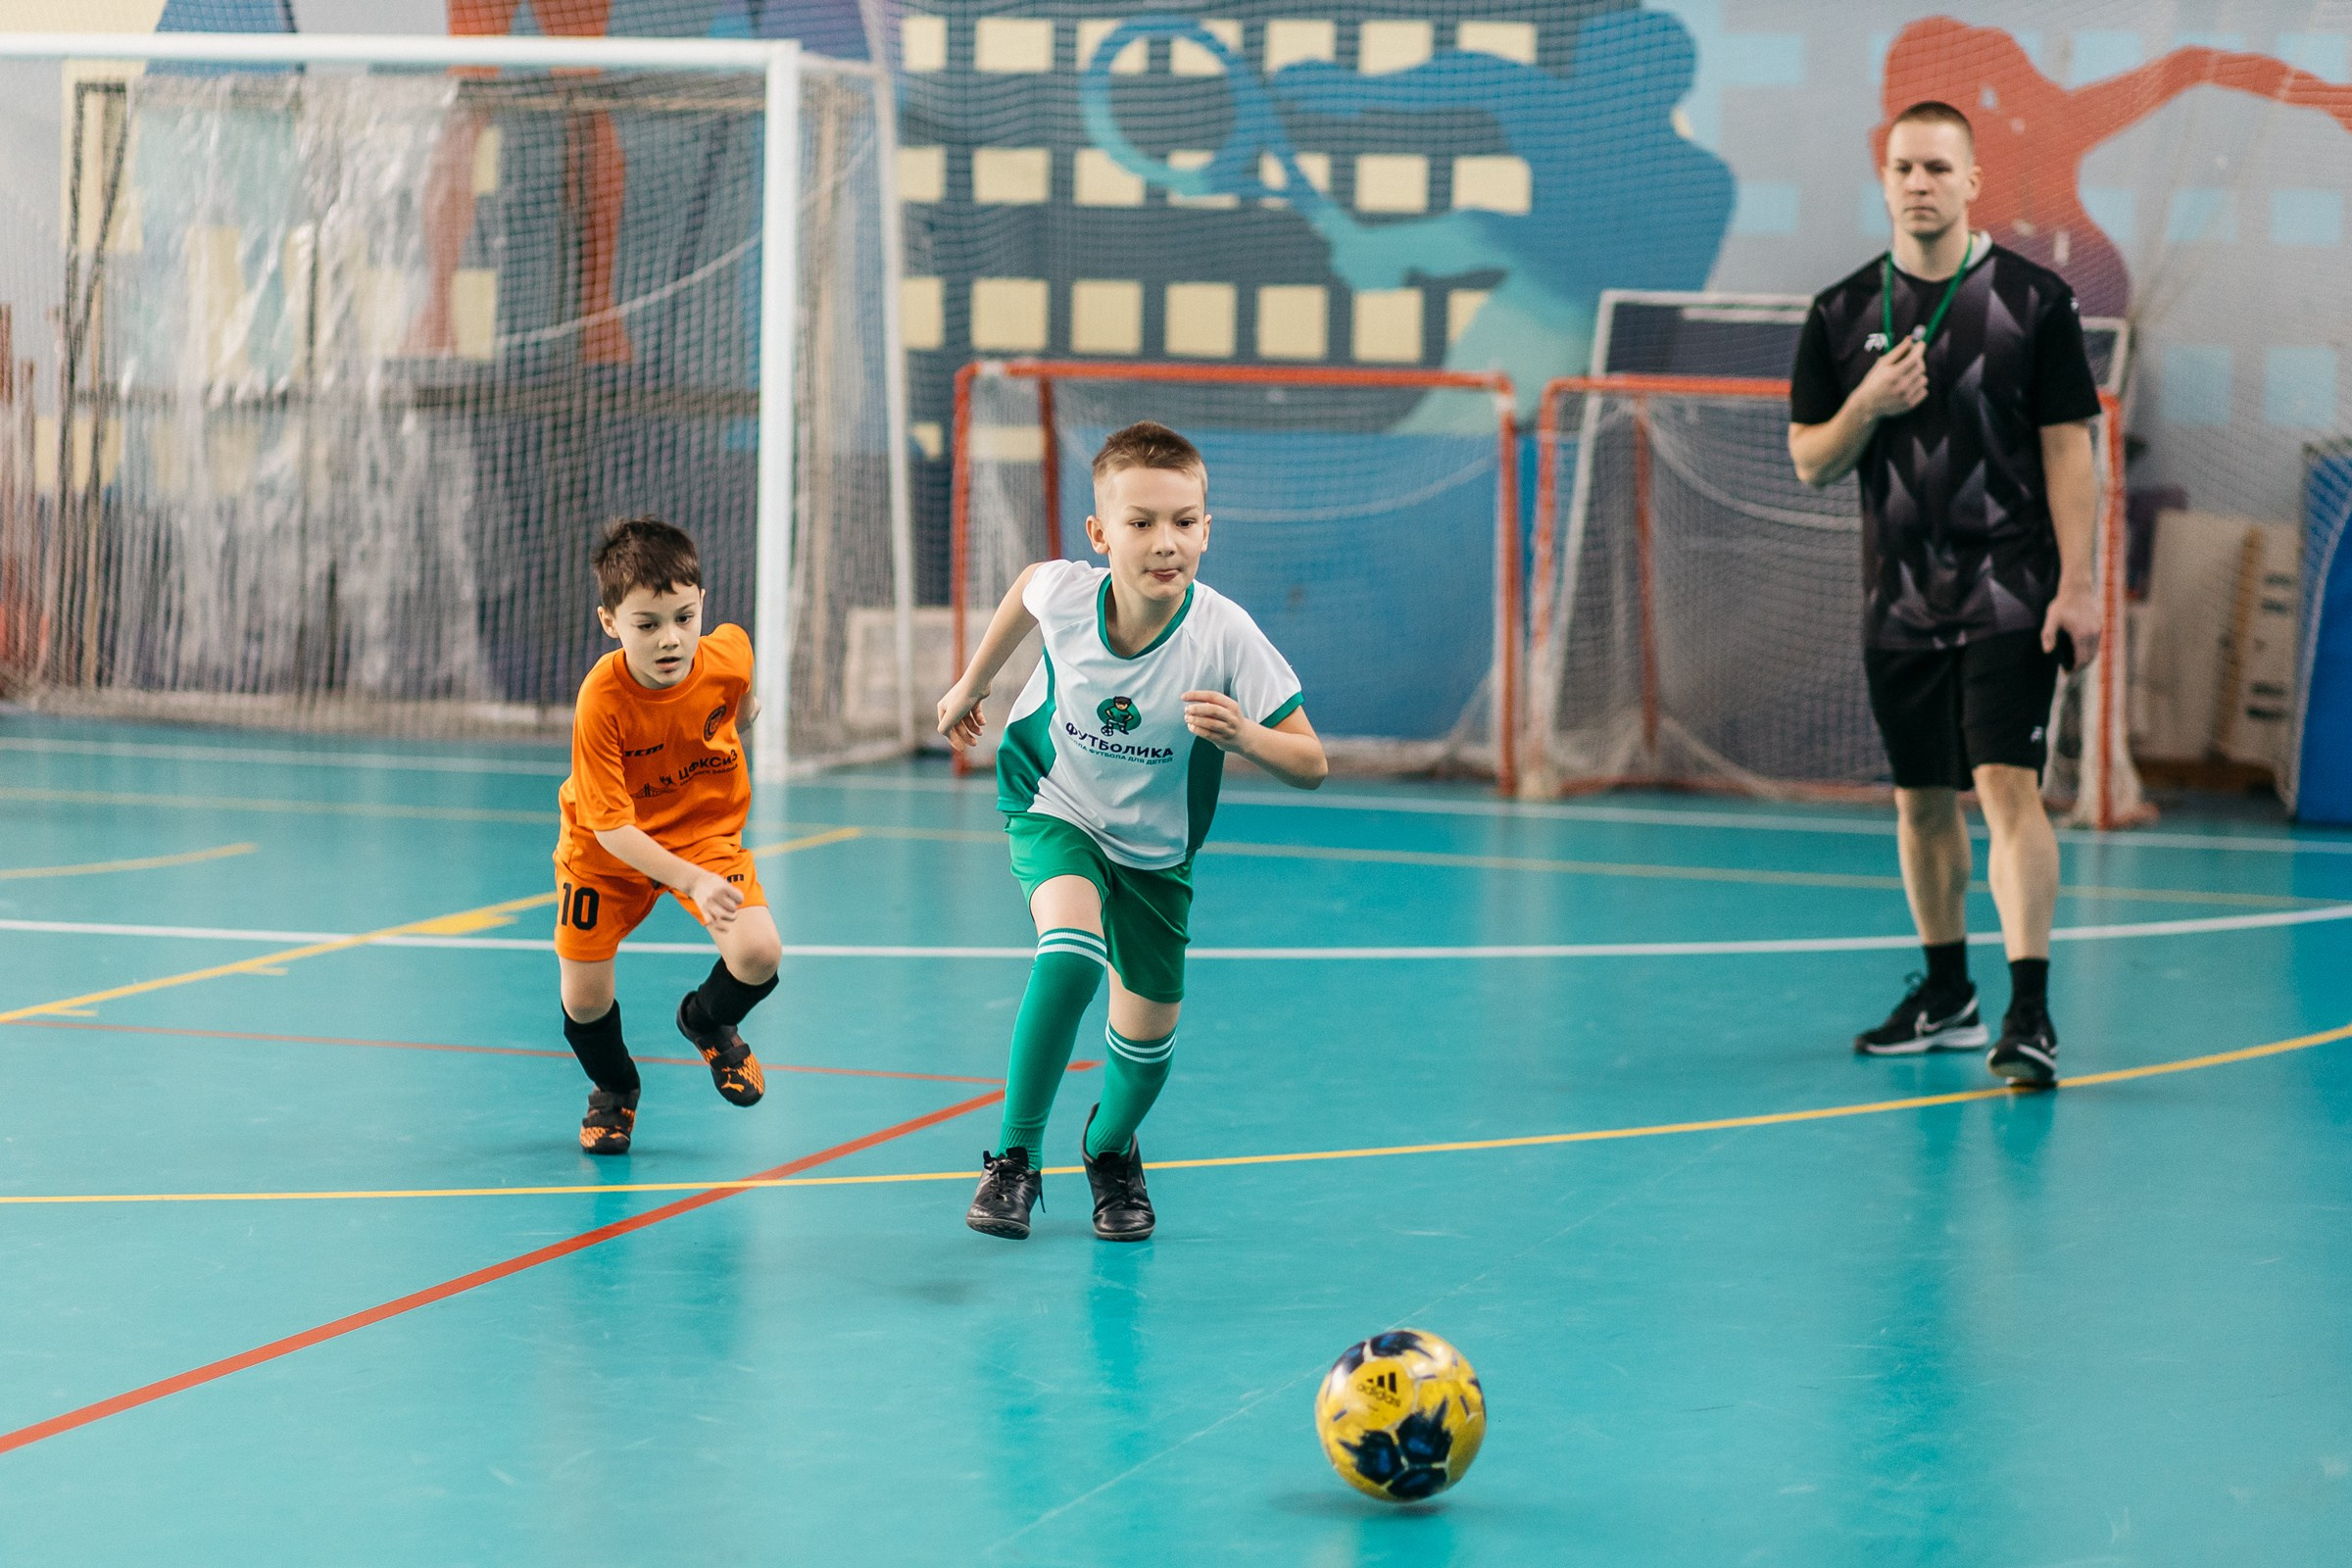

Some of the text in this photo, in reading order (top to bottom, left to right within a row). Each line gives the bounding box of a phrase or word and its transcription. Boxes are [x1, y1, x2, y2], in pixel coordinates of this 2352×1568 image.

[1065, 722, 1173, 759] ФУТБОЛИКА
[1089, 749, 1126, 760] ФУТБОЛА
[1127, 756, 1145, 764] ДЛЯ
[1145, 756, 1174, 765] ДЕТЕЙ
[561, 882, 600, 931] 10
